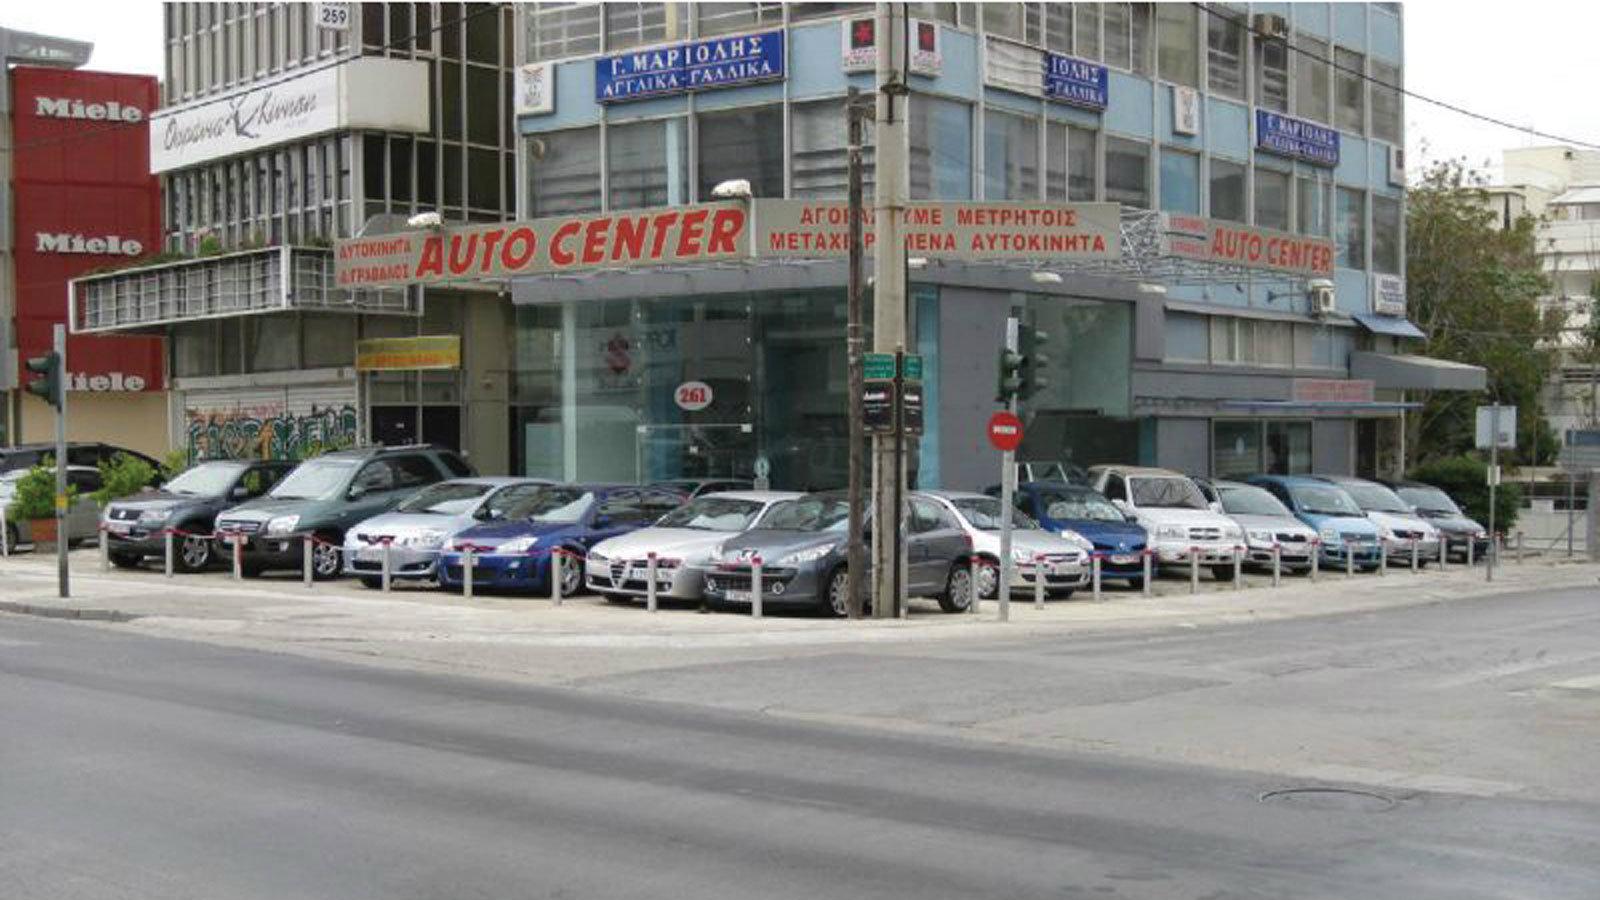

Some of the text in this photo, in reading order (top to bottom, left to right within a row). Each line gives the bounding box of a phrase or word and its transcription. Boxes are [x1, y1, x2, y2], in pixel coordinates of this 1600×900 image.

[322, 7, 347, 25] 259
[633, 37, 763, 72] ΜΑΡΙΟΛΗΣ
[35, 96, 143, 122] Miele
[957, 207, 1076, 227] ΜΕΤΡΗΤΟΙΣ
[35, 231, 144, 256] Miele
[415, 207, 746, 279] AUTO CENTER
[971, 232, 1106, 252] ΑΥΤΟΚΙΝΗΤΑ
[1212, 226, 1263, 262] AUTO
[1267, 237, 1332, 273] CENTER
[680, 387, 706, 404] 261
